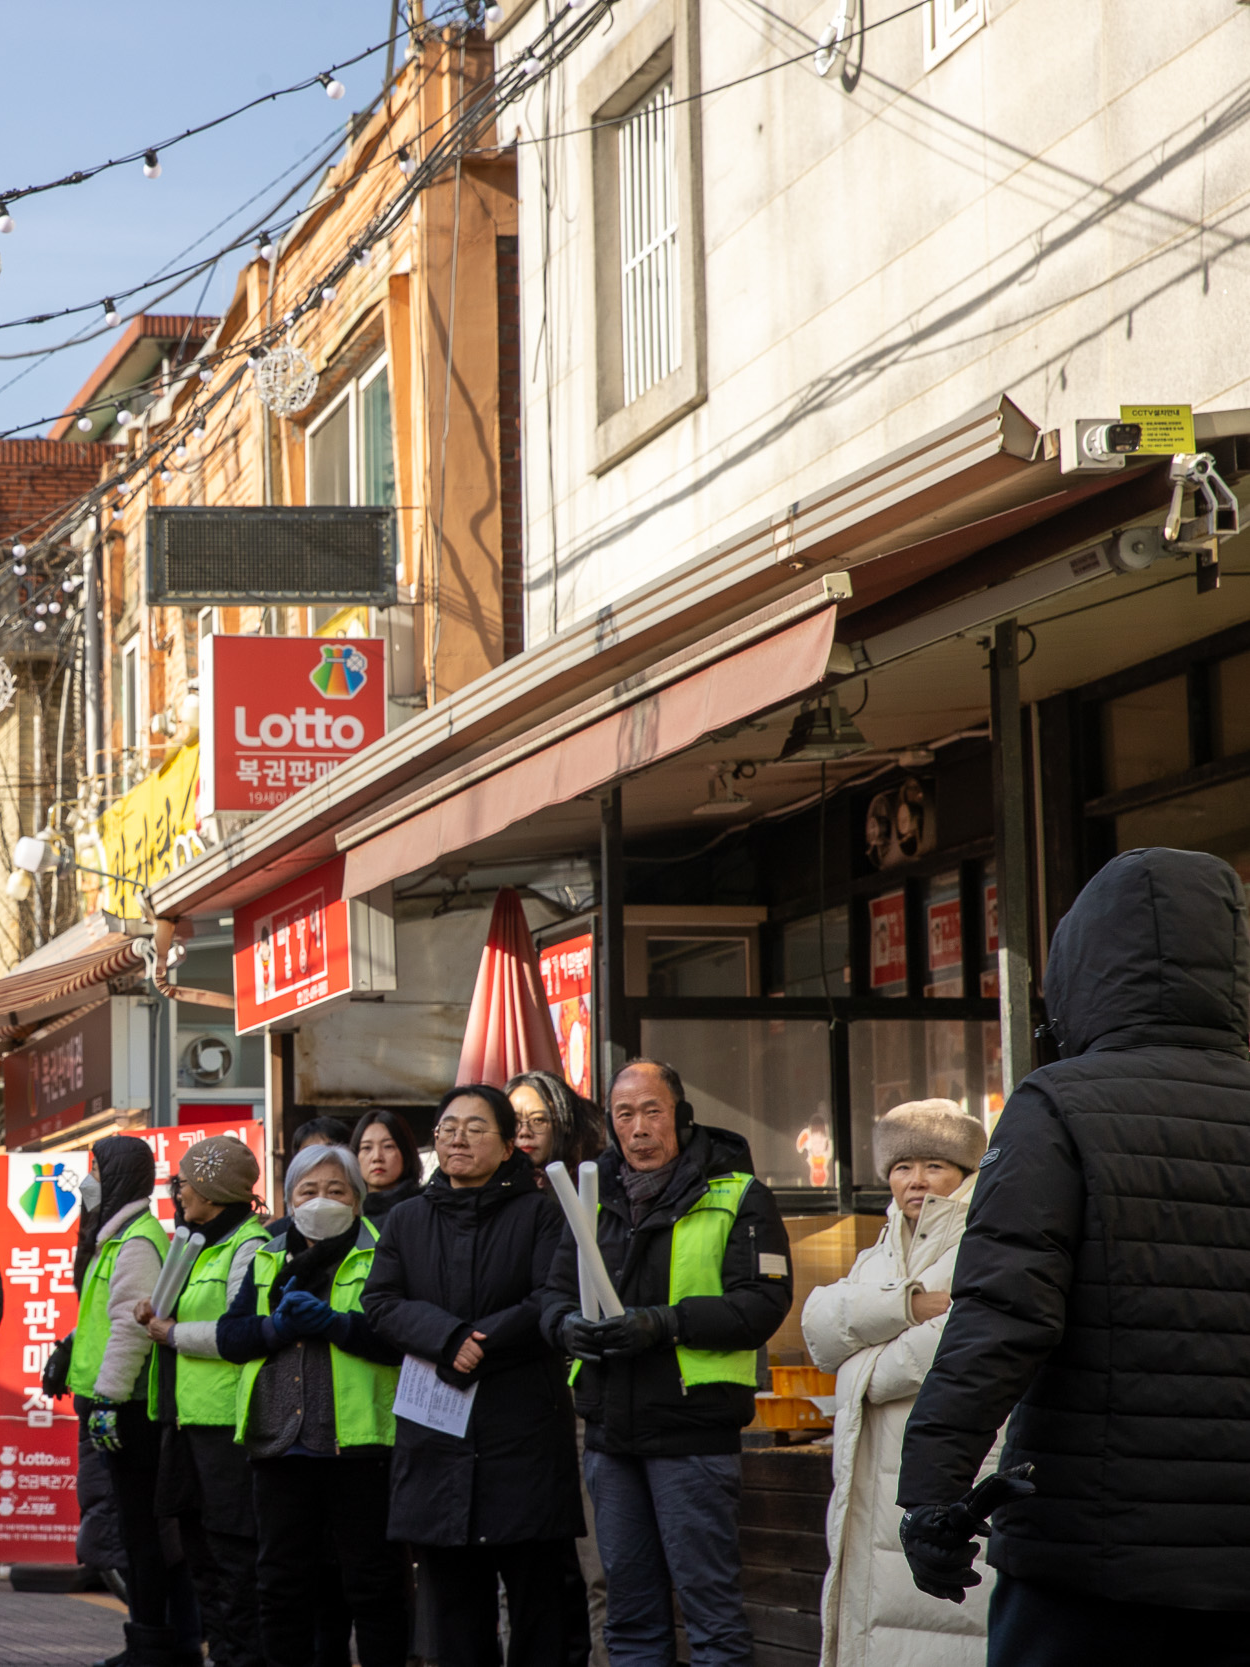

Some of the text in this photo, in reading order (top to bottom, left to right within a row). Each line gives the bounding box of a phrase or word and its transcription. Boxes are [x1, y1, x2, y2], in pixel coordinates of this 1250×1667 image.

[235, 706, 364, 749] Lotto
[236, 759, 338, 787] 복권판매
[5, 1246, 78, 1294] 복권
[22, 1299, 61, 1428] 판매점
[18, 1451, 55, 1467] Lotto
[17, 1474, 78, 1490] 연금복권72
